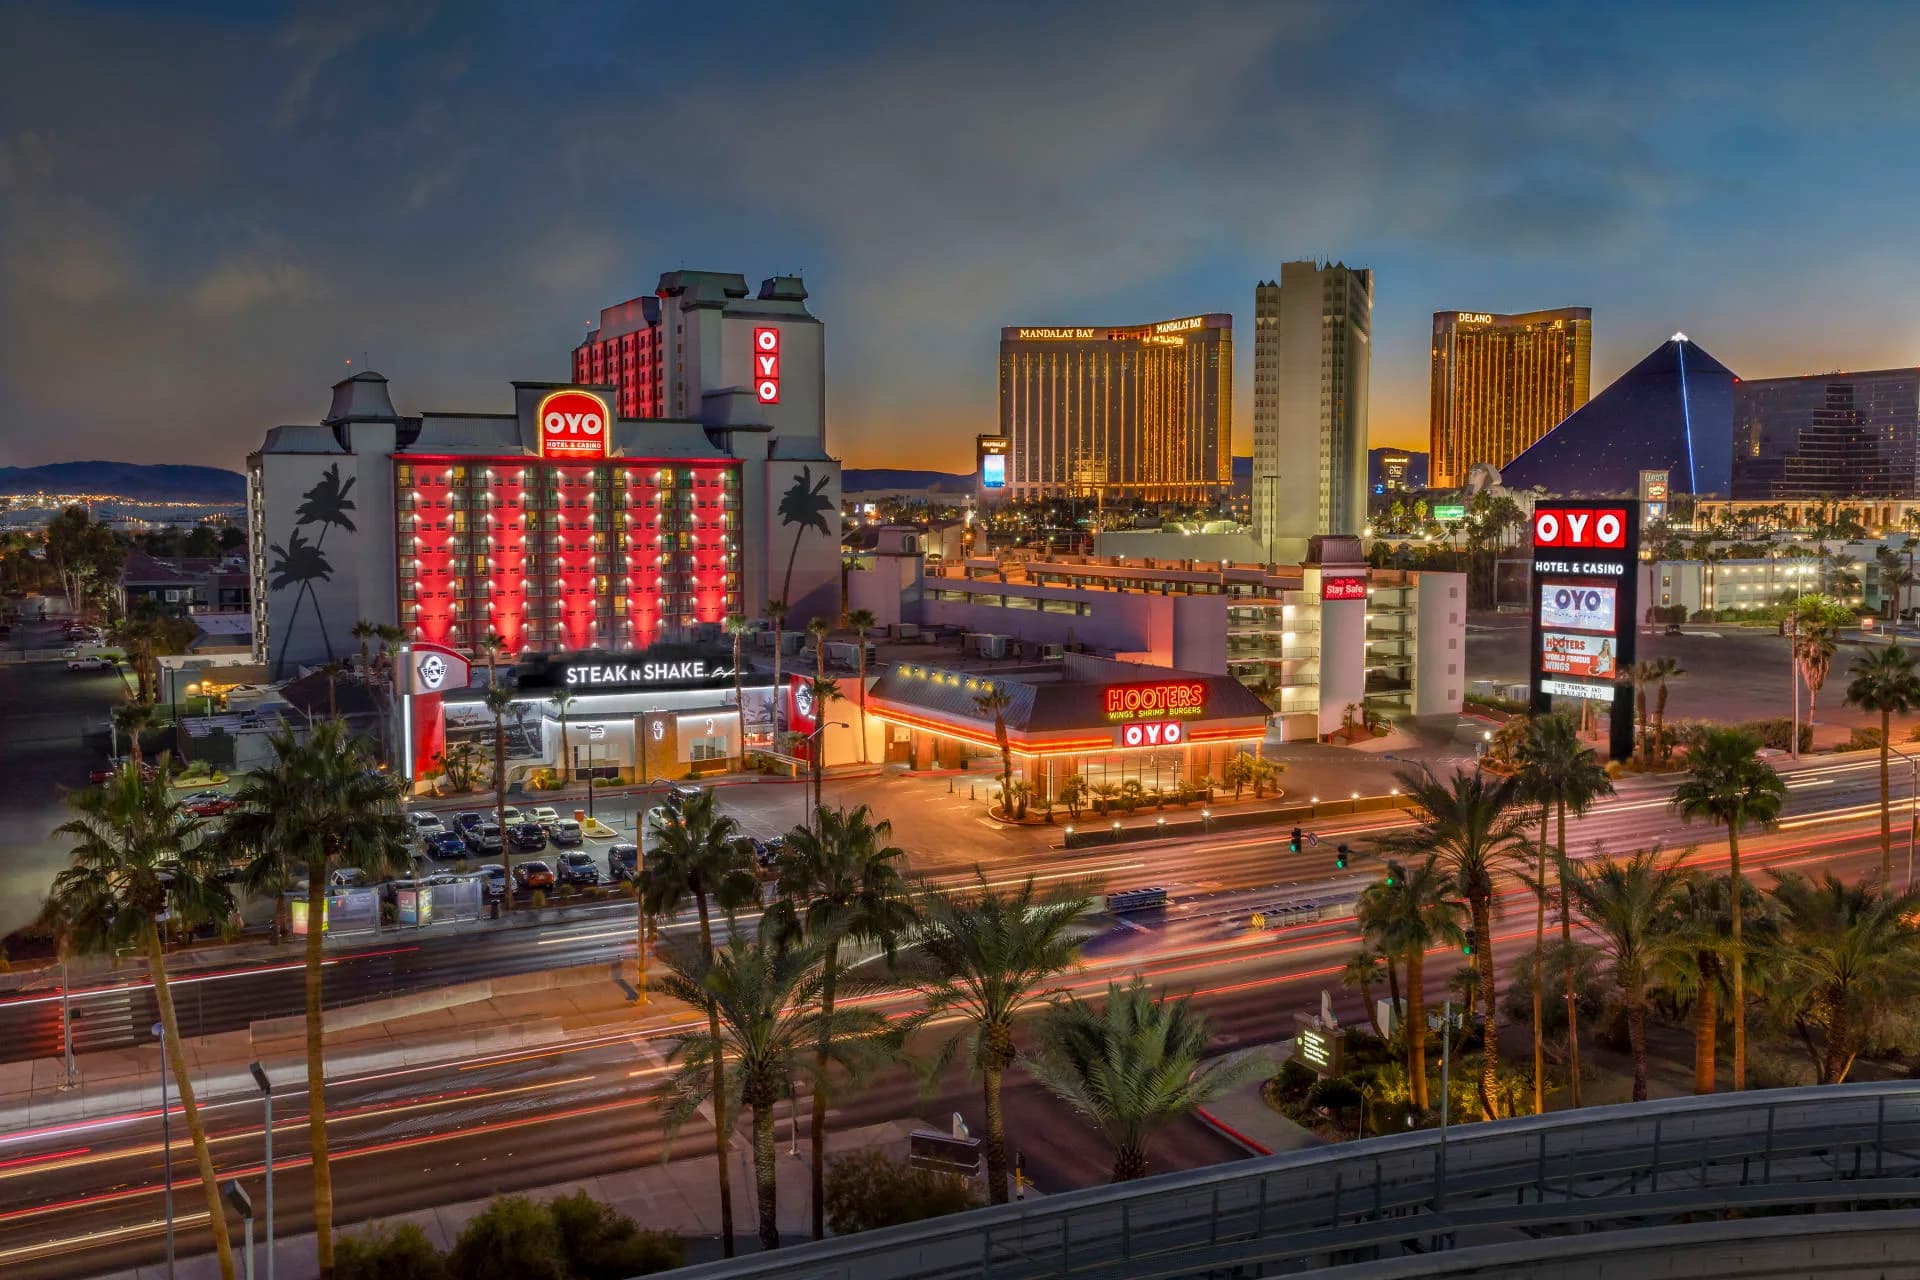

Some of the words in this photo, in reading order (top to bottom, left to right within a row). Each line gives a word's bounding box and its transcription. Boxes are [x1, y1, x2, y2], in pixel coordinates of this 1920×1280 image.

[1156, 319, 1190, 334] MANDALAY
[1190, 317, 1202, 328] BAY
[1459, 313, 1492, 324] DELANO
[1020, 329, 1074, 338] MANDALAY
[1076, 329, 1095, 338] BAY
[758, 331, 777, 401] OYO
[545, 412, 602, 435] OYO
[1537, 514, 1620, 543] OYO
[1535, 562, 1569, 573] HOTEL
[1572, 563, 1580, 573] &
[1583, 563, 1624, 575] CASINO
[1327, 585, 1344, 596] Stay
[1345, 584, 1364, 593] Safe
[1555, 589, 1601, 611] OYO
[1546, 637, 1586, 651] HOOTERS
[566, 665, 628, 683] STEAK
[631, 669, 641, 681] N
[644, 662, 704, 680] SHAKE
[1545, 660, 1570, 672] WINGS
[1108, 685, 1202, 711] HOOTERS
[1109, 710, 1134, 719] WINGS
[1139, 708, 1165, 718] SHRIMP
[1169, 706, 1201, 715] BURGERS
[1126, 724, 1180, 745] OYO
